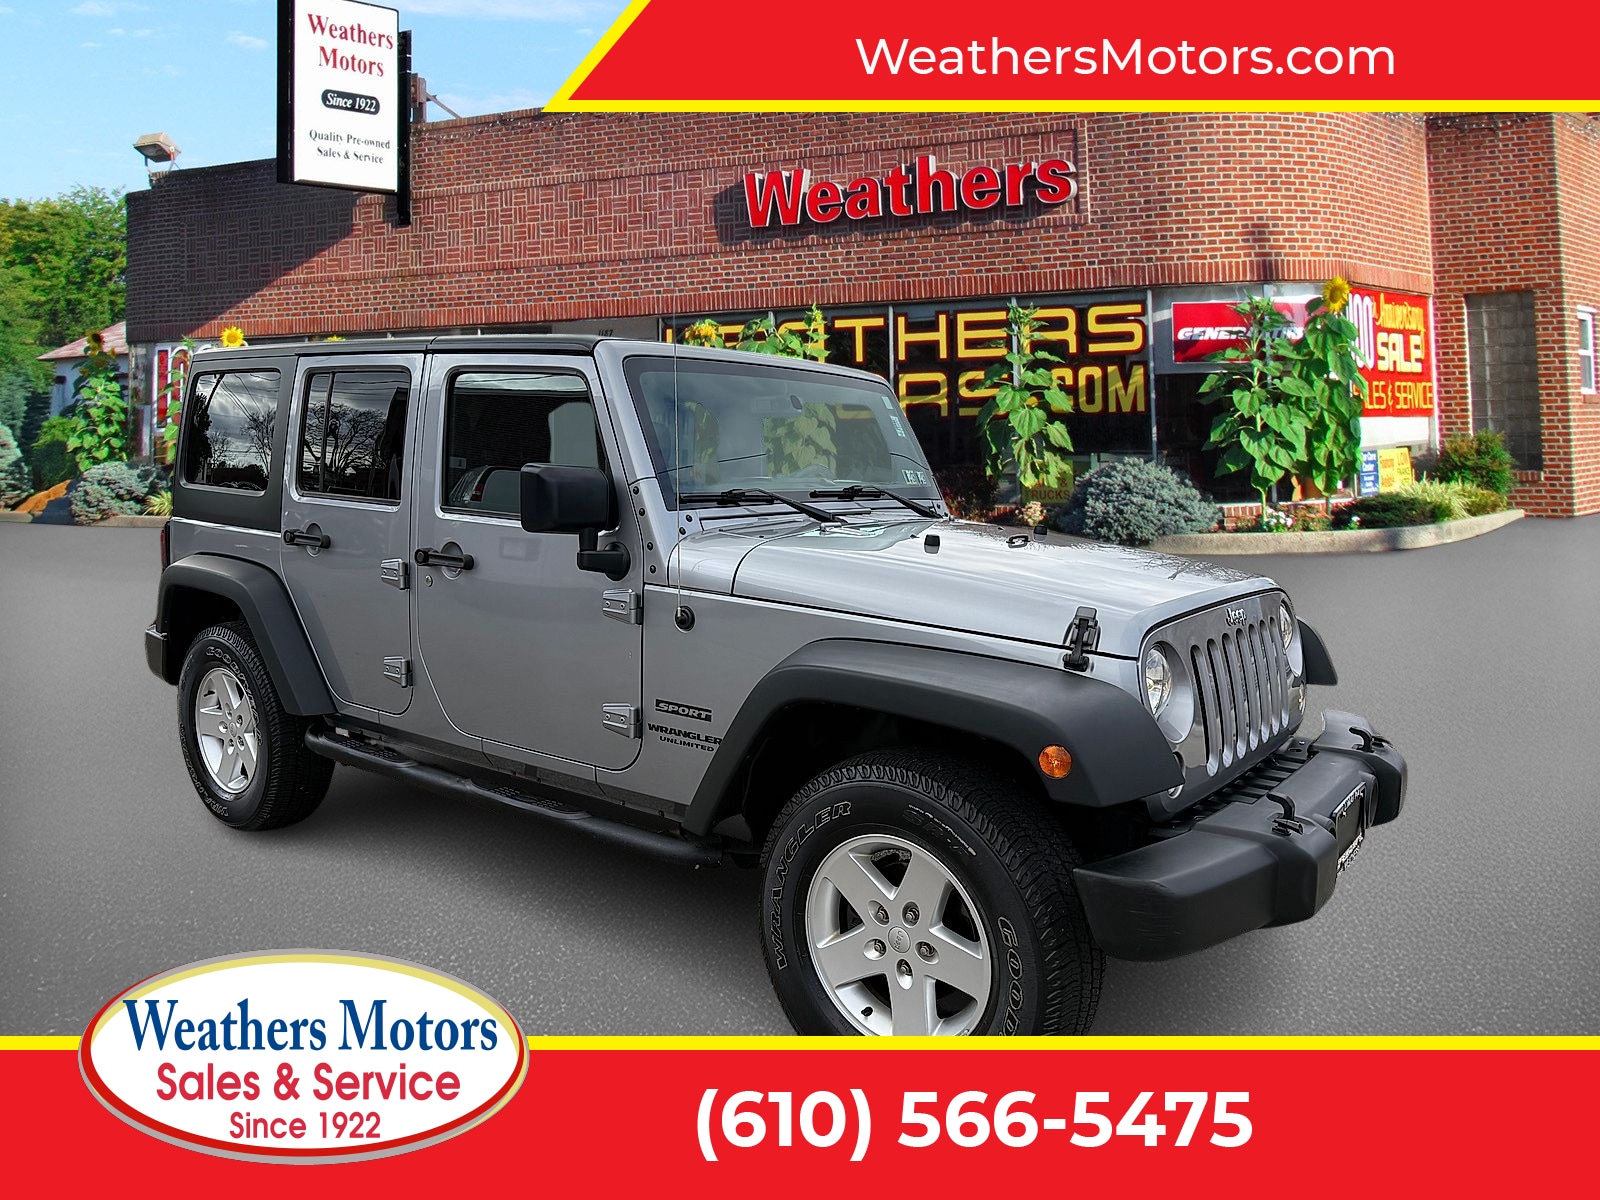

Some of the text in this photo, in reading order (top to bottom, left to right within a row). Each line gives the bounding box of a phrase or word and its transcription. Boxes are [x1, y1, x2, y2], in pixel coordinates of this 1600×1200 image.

[307, 13, 394, 50] Weathers
[318, 45, 384, 77] Motors
[326, 92, 377, 112] Since 1922
[309, 129, 390, 149] Quality Pre-owned
[317, 146, 384, 164] Sales & Service
[743, 155, 1077, 228] Weathers
[1377, 332, 1423, 373] SALE
[1394, 381, 1434, 409] SERVICE
[1029, 489, 1071, 500] RUCKS
[658, 702, 708, 719] SPORT
[648, 723, 722, 746] WRANGLER
[660, 736, 715, 752] UNLIMITED
[771, 801, 852, 970] WRANGLER
[998, 916, 1023, 1036] GOOD
